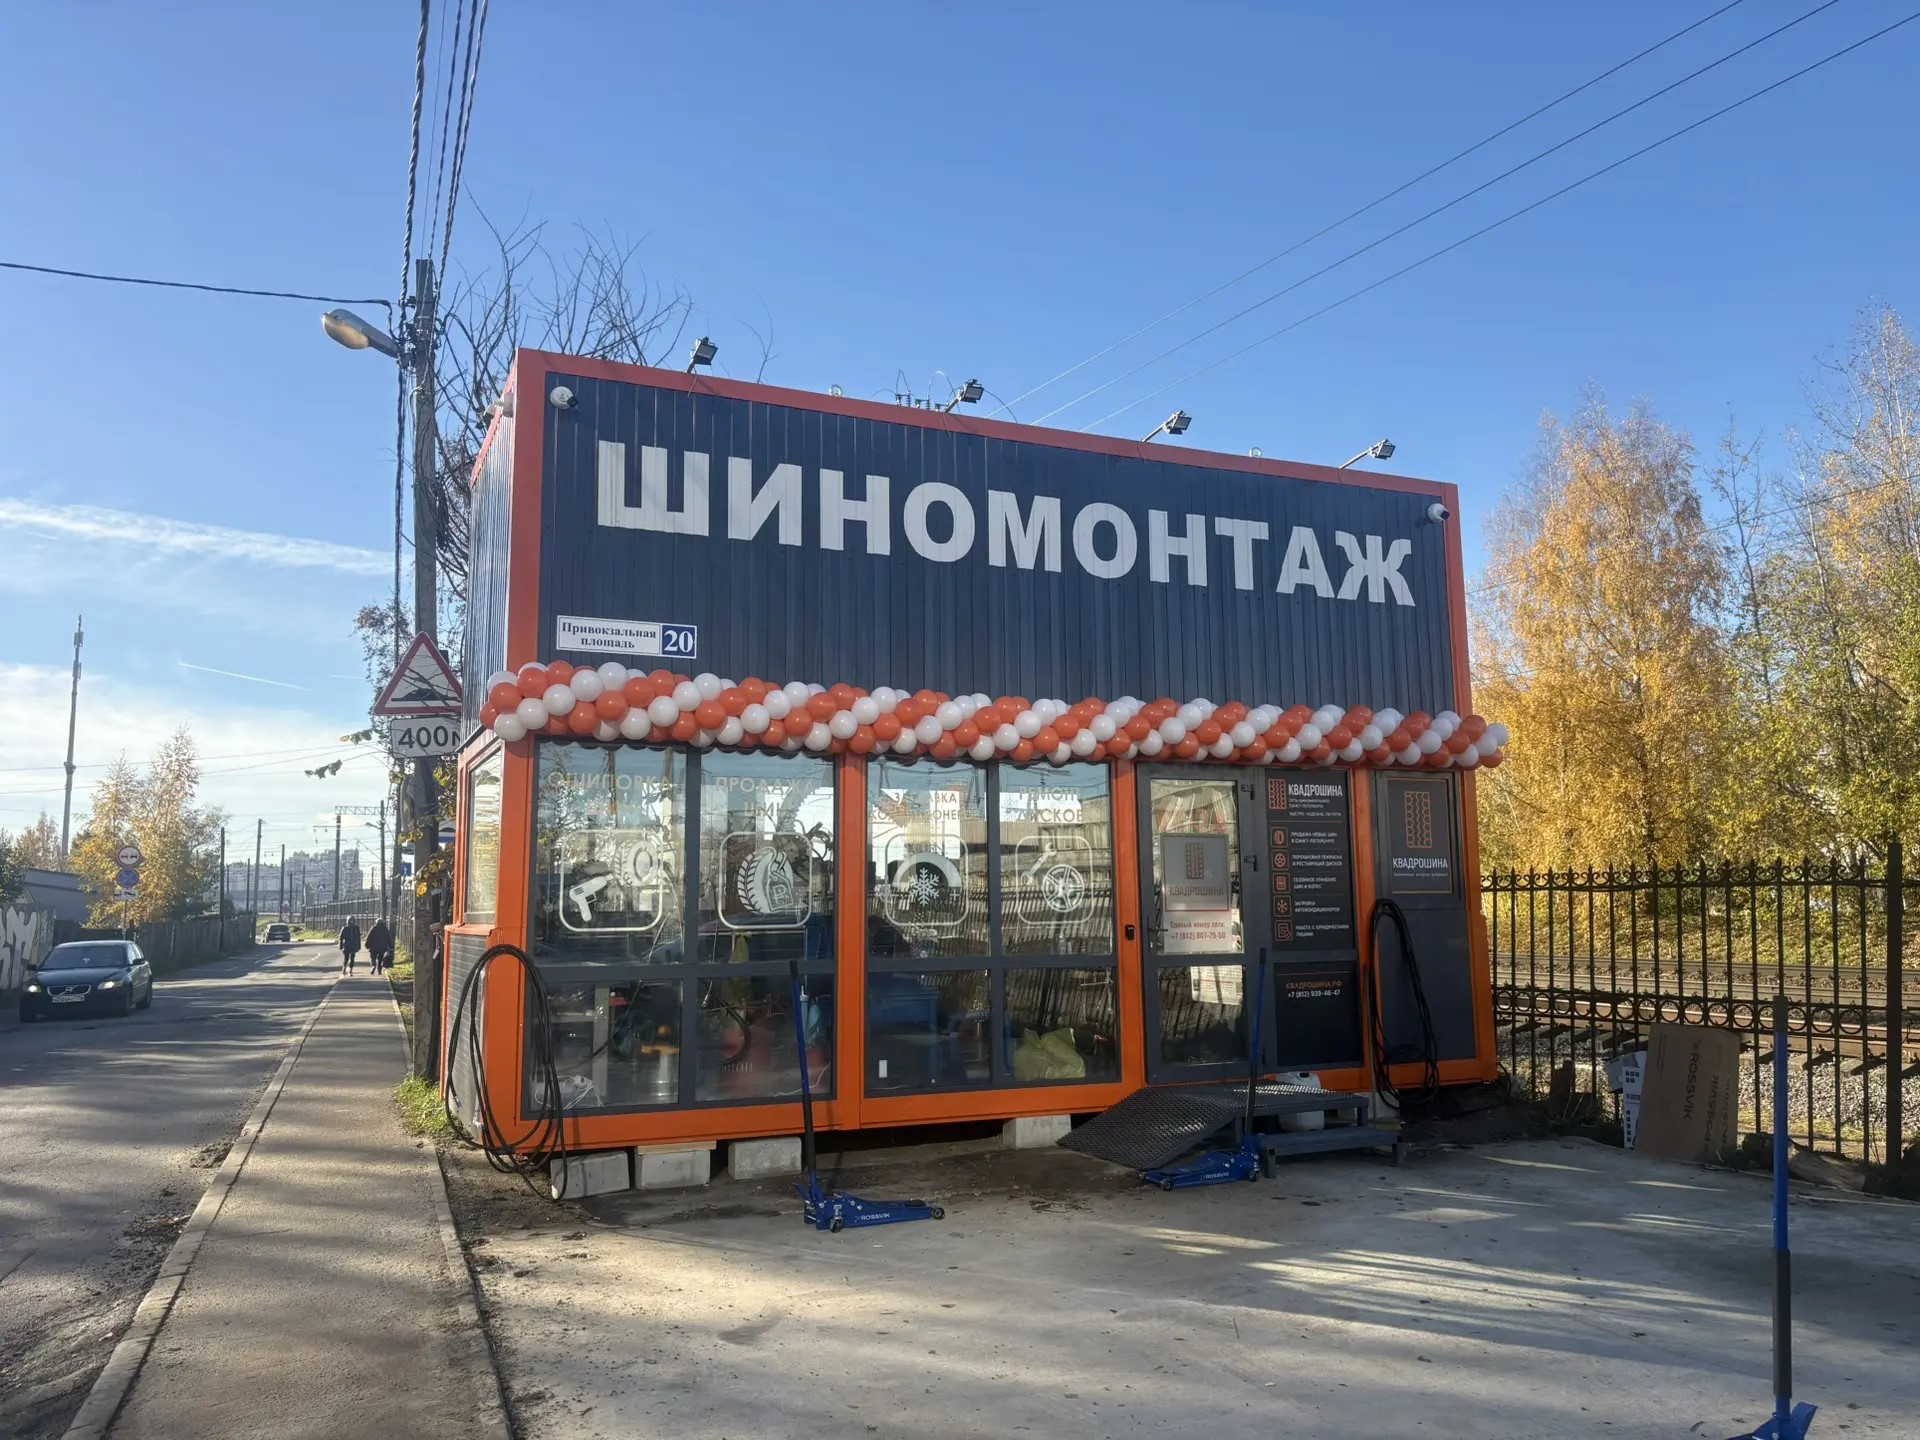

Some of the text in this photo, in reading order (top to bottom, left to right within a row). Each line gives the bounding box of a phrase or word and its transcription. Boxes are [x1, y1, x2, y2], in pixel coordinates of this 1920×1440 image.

[597, 440, 1416, 607] ШИНОМОНТАЖ
[562, 622, 656, 639] Привокзальная
[581, 636, 635, 649] площадь
[664, 630, 693, 653] 20
[1288, 784, 1343, 797] КВАДРОШИНА
[1393, 858, 1448, 869] КВАДРОШИНА
[1683, 1052, 1699, 1120] ROSSVIK
[1704, 1073, 1719, 1142] ROSSVIK
[861, 1213, 891, 1221] ROSSVIK
